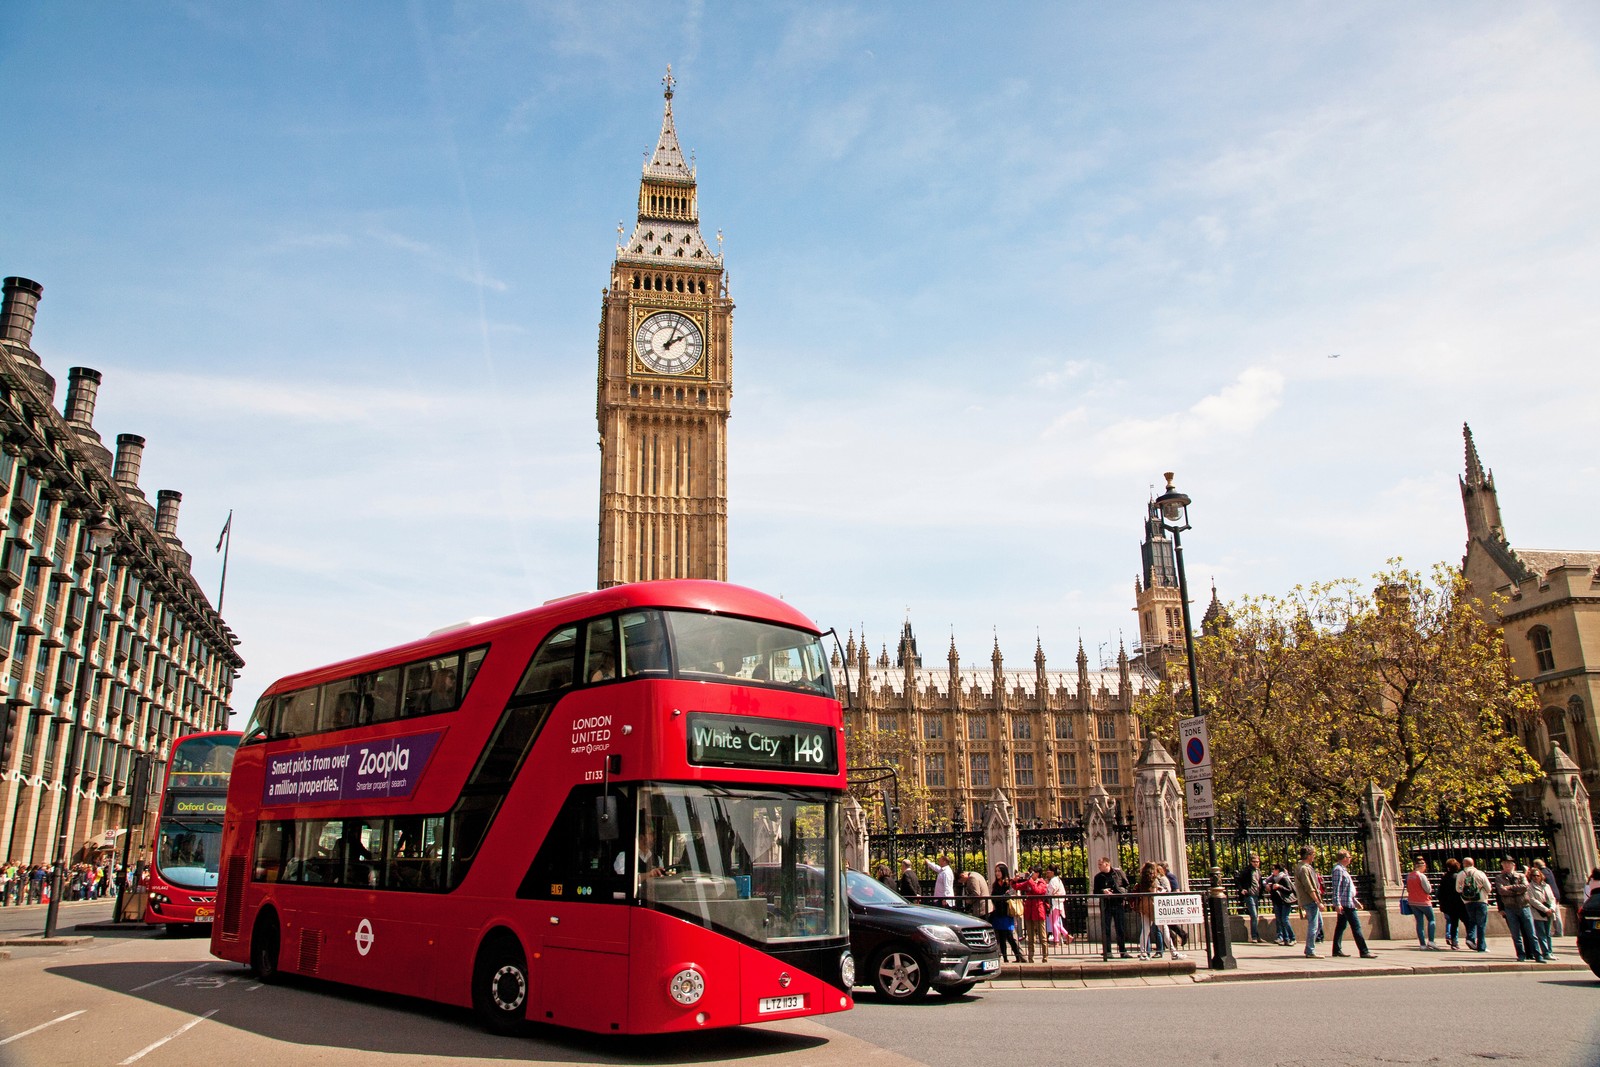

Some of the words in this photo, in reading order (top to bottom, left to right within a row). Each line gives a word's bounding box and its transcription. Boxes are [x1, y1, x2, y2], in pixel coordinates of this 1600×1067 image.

[572, 715, 612, 731] LONDON
[1180, 718, 1204, 728] Controlled
[572, 729, 611, 745] UNITED
[1185, 726, 1202, 737] ZONE
[571, 746, 586, 754] RATP
[592, 743, 610, 752] GROUP
[694, 726, 742, 750] White
[748, 732, 780, 757] City
[794, 733, 824, 763] 148
[271, 759, 293, 776] Smart
[292, 756, 313, 776] picks
[312, 755, 331, 771] from
[331, 754, 350, 769] over
[358, 744, 410, 779] Zoopla
[585, 770, 603, 781] LT133
[268, 784, 274, 796] a
[274, 779, 298, 796] million
[297, 775, 339, 797] properties.
[356, 781, 373, 791] Smarter
[390, 778, 407, 788] search
[177, 801, 205, 811] Oxford
[1157, 897, 1198, 907] PARLIAMENT
[195, 907, 210, 916] Go
[1158, 907, 1185, 916] SQUARE
[1186, 906, 1200, 915] SW1
[766, 998, 782, 1010] LTZ
[783, 996, 798, 1008] 1133
